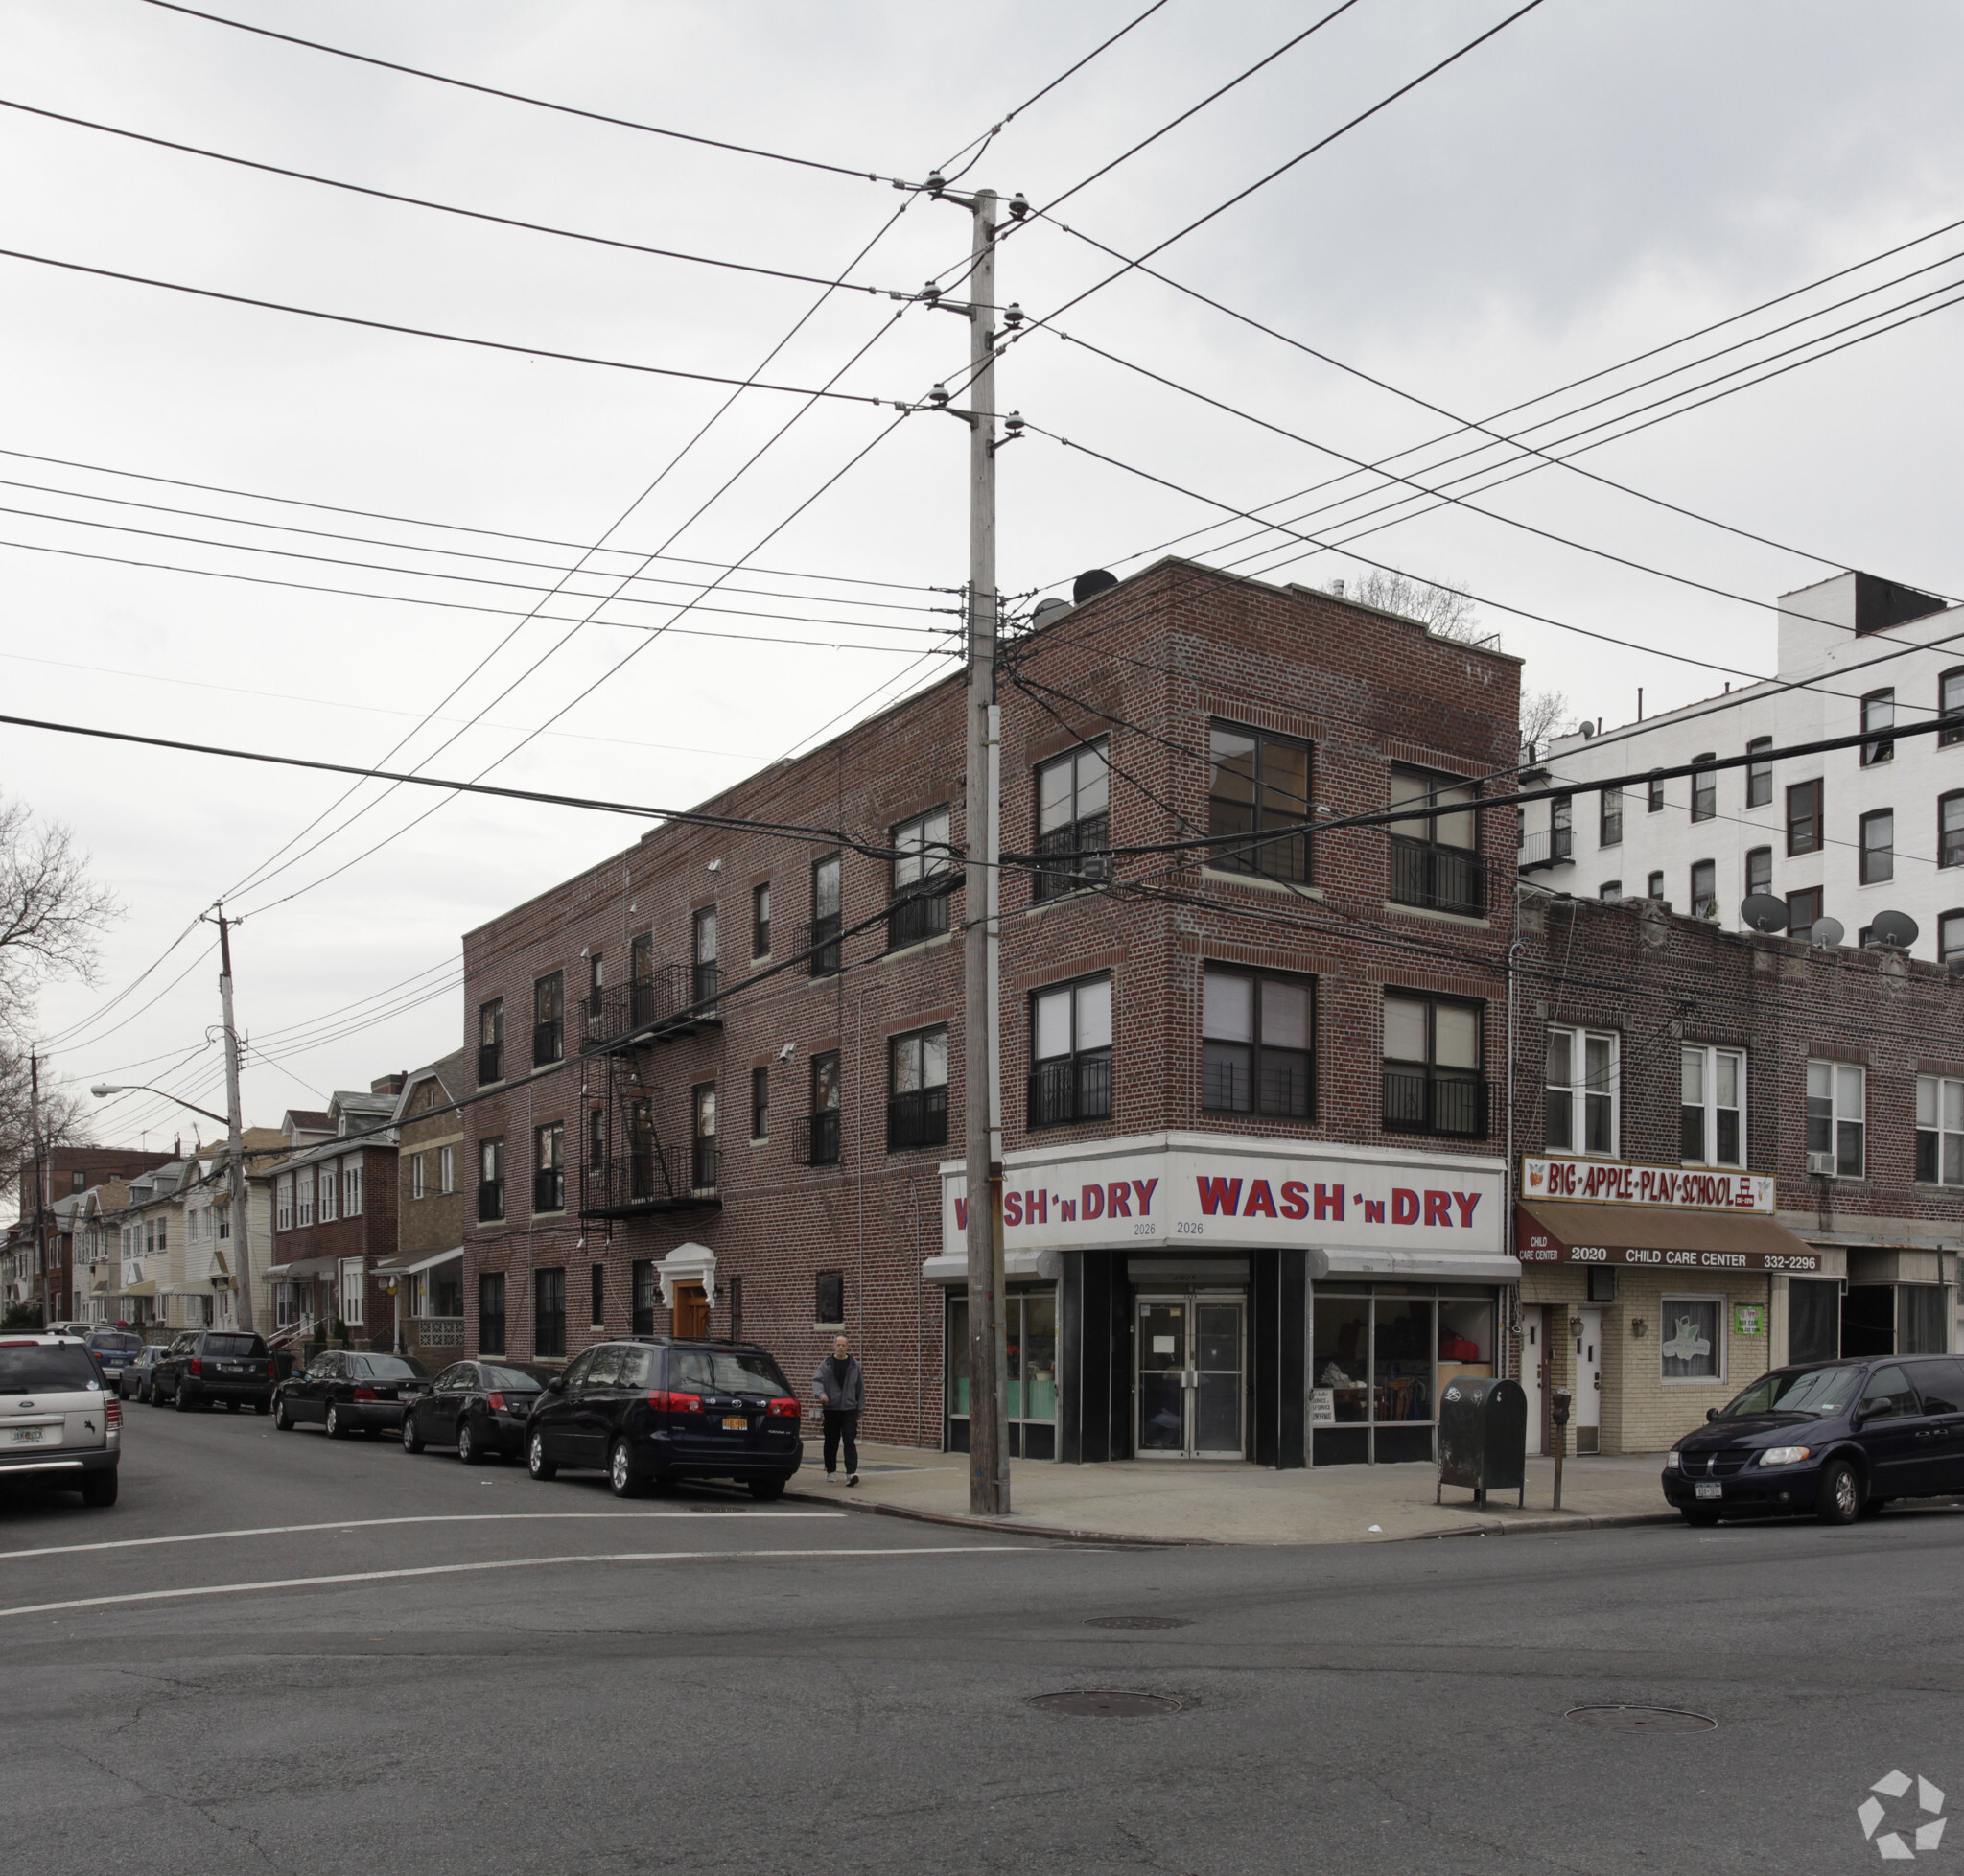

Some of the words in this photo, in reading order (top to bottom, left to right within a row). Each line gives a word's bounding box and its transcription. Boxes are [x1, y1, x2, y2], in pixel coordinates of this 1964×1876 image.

[1547, 1162, 1576, 1195] BIG
[1582, 1166, 1633, 1198] APPLE
[1641, 1170, 1679, 1203] PLAY
[1680, 1174, 1735, 1206] SCHOOL
[1082, 1178, 1159, 1221] DRY
[1196, 1176, 1345, 1222] WASH
[1391, 1187, 1483, 1228] DRY
[1134, 1224, 1156, 1235] 2026
[1177, 1222, 1204, 1234] 2026
[1531, 1236, 1547, 1247] CHILD
[1519, 1250, 1534, 1260] CARE
[1535, 1250, 1558, 1260] CENTER
[1571, 1247, 1607, 1261] 2020
[1625, 1250, 1662, 1263] CHILD
[1666, 1252, 1697, 1265] CARE
[1701, 1253, 1746, 1267] CENTER
[1764, 1255, 1816, 1269] 332-2296
